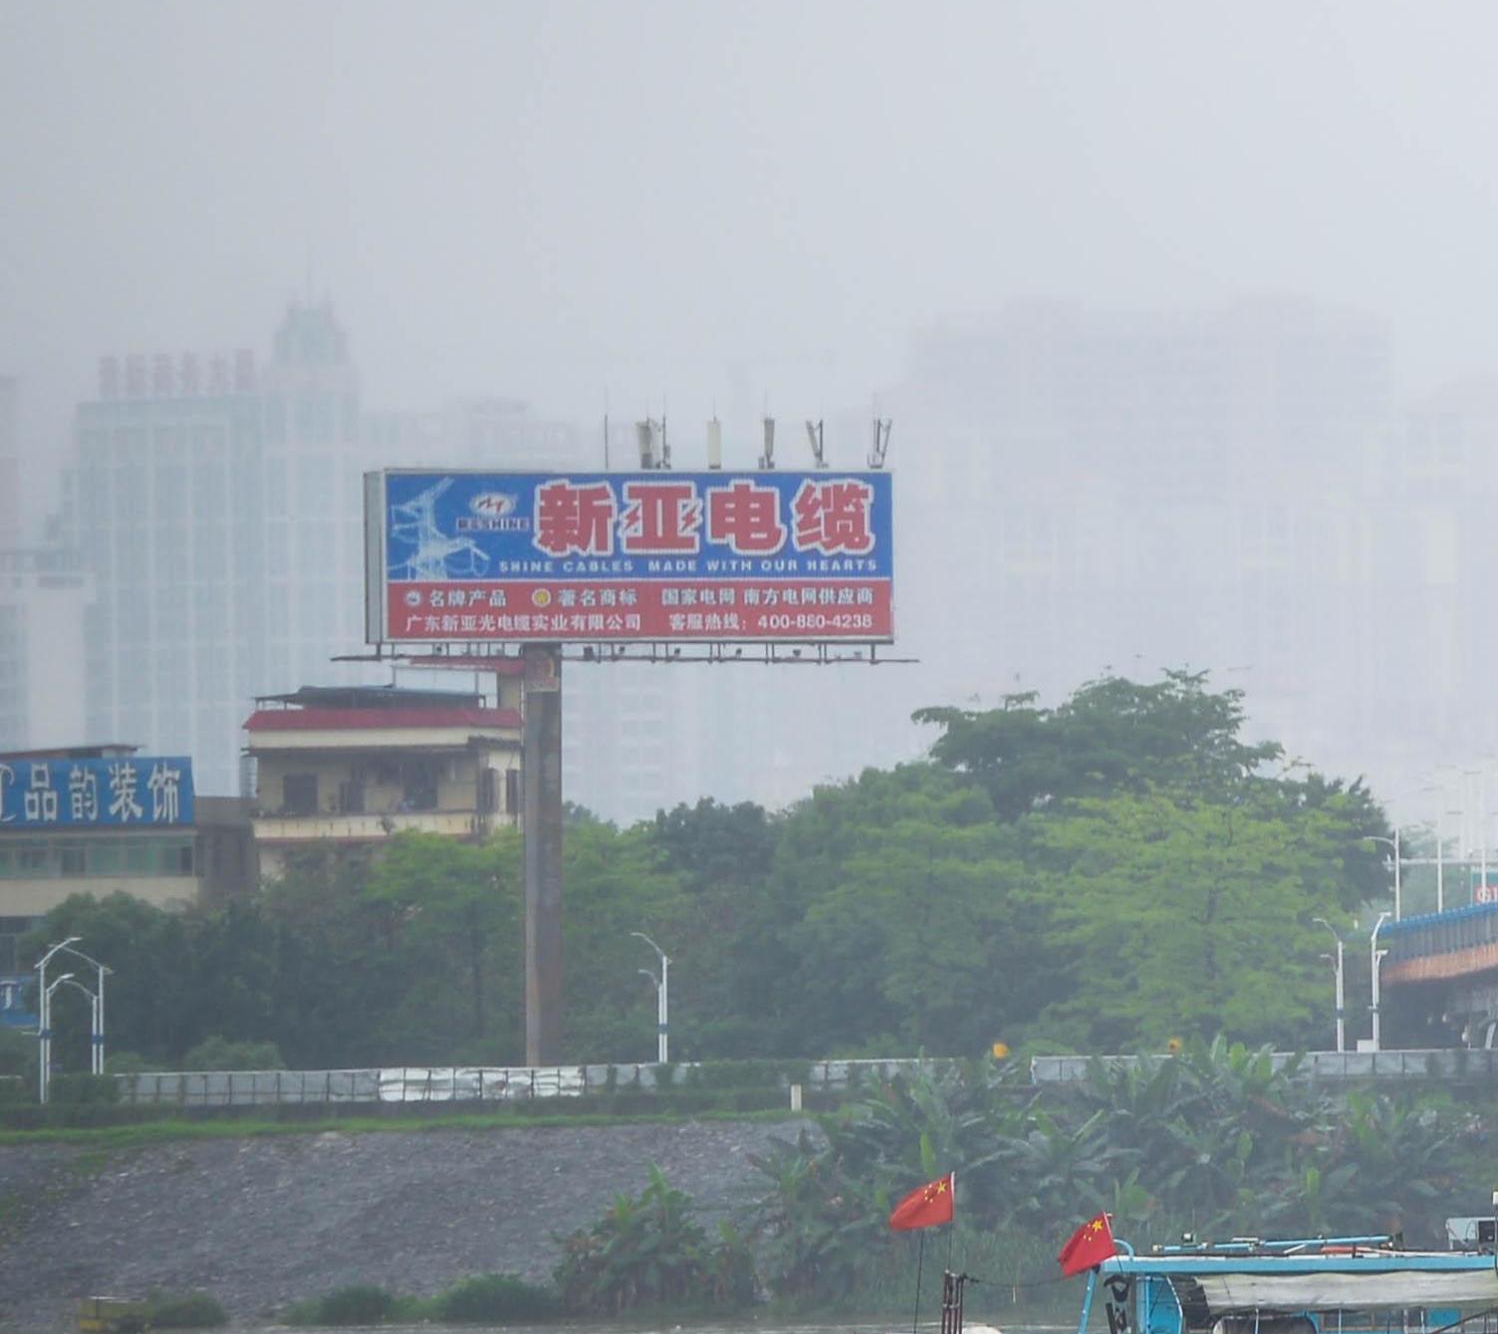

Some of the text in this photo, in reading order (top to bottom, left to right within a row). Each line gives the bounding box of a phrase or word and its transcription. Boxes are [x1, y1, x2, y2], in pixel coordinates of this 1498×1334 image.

[533, 478, 875, 555] 新亚电缆
[499, 560, 877, 573] SHINE CABLES MADE WITH OUR HEARTS
[429, 589, 507, 607] 名牌产品
[558, 588, 638, 607] 著名商标
[661, 587, 874, 606] 国家电网 南方电网供应商
[405, 614, 641, 631] 广东新亚光电缆实业有限公司
[24, 759, 181, 824] 品韵装饰
